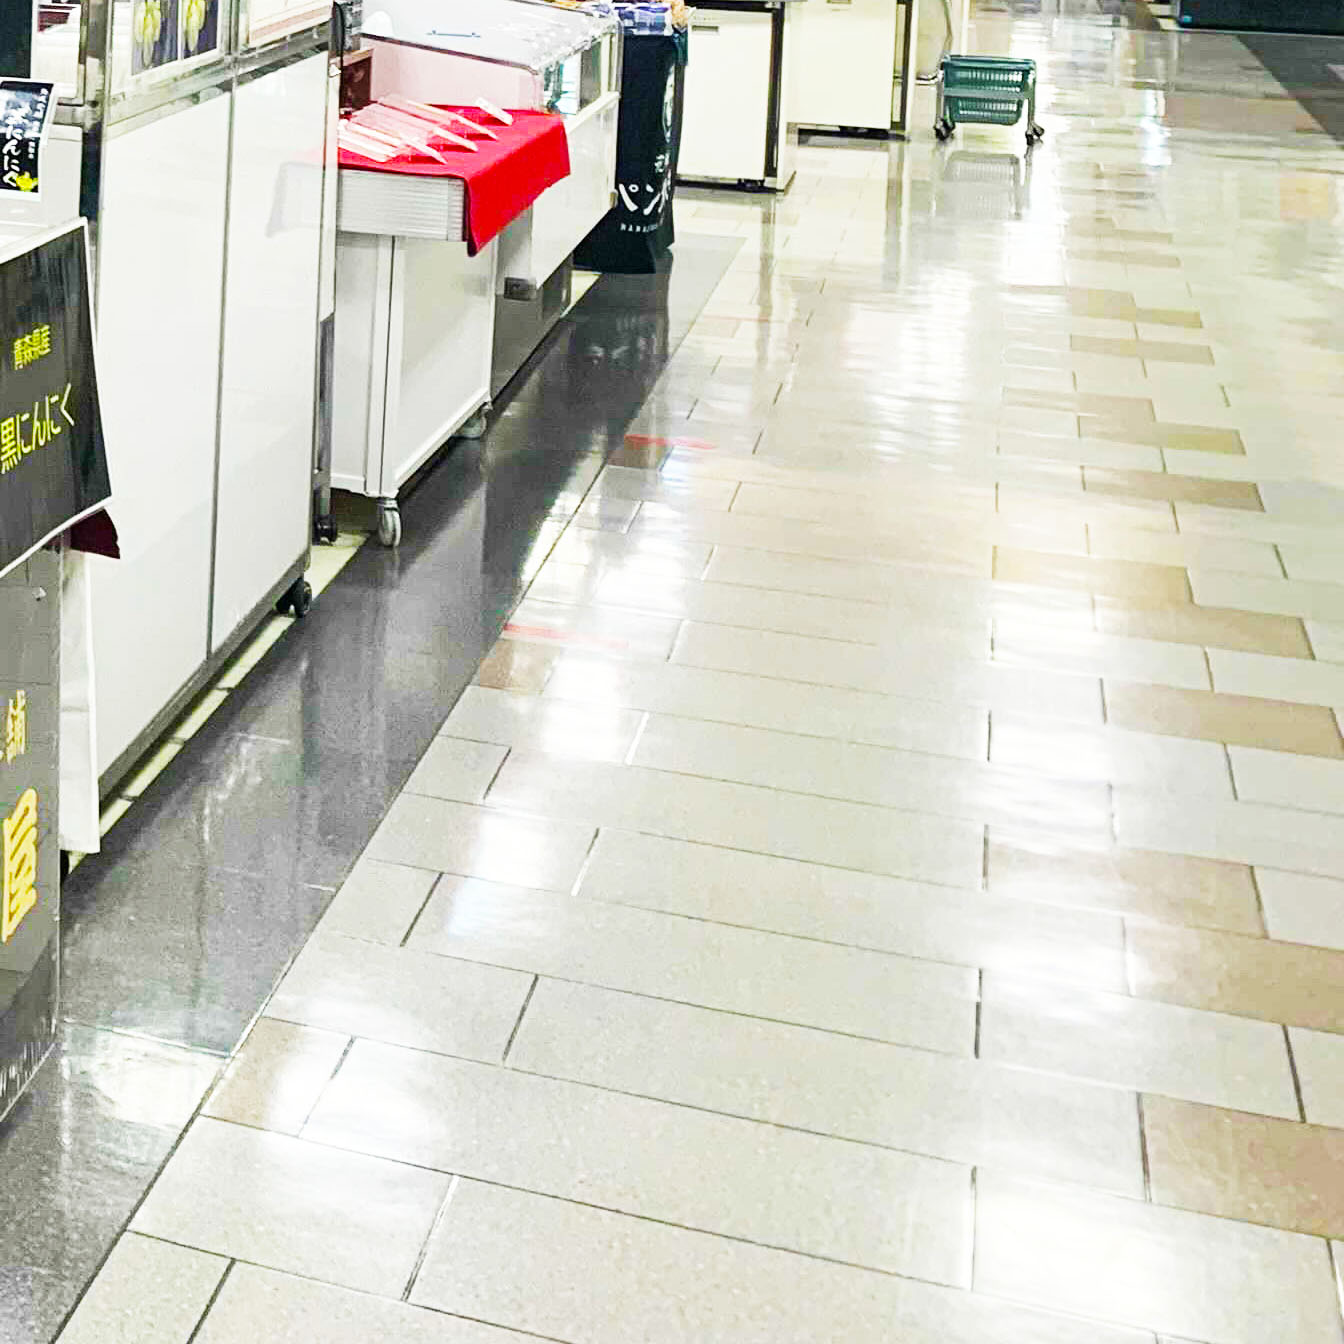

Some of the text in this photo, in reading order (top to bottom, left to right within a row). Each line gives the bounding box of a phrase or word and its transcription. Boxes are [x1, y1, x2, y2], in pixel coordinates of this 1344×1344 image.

[0, 382, 76, 475] 黒にんにく
